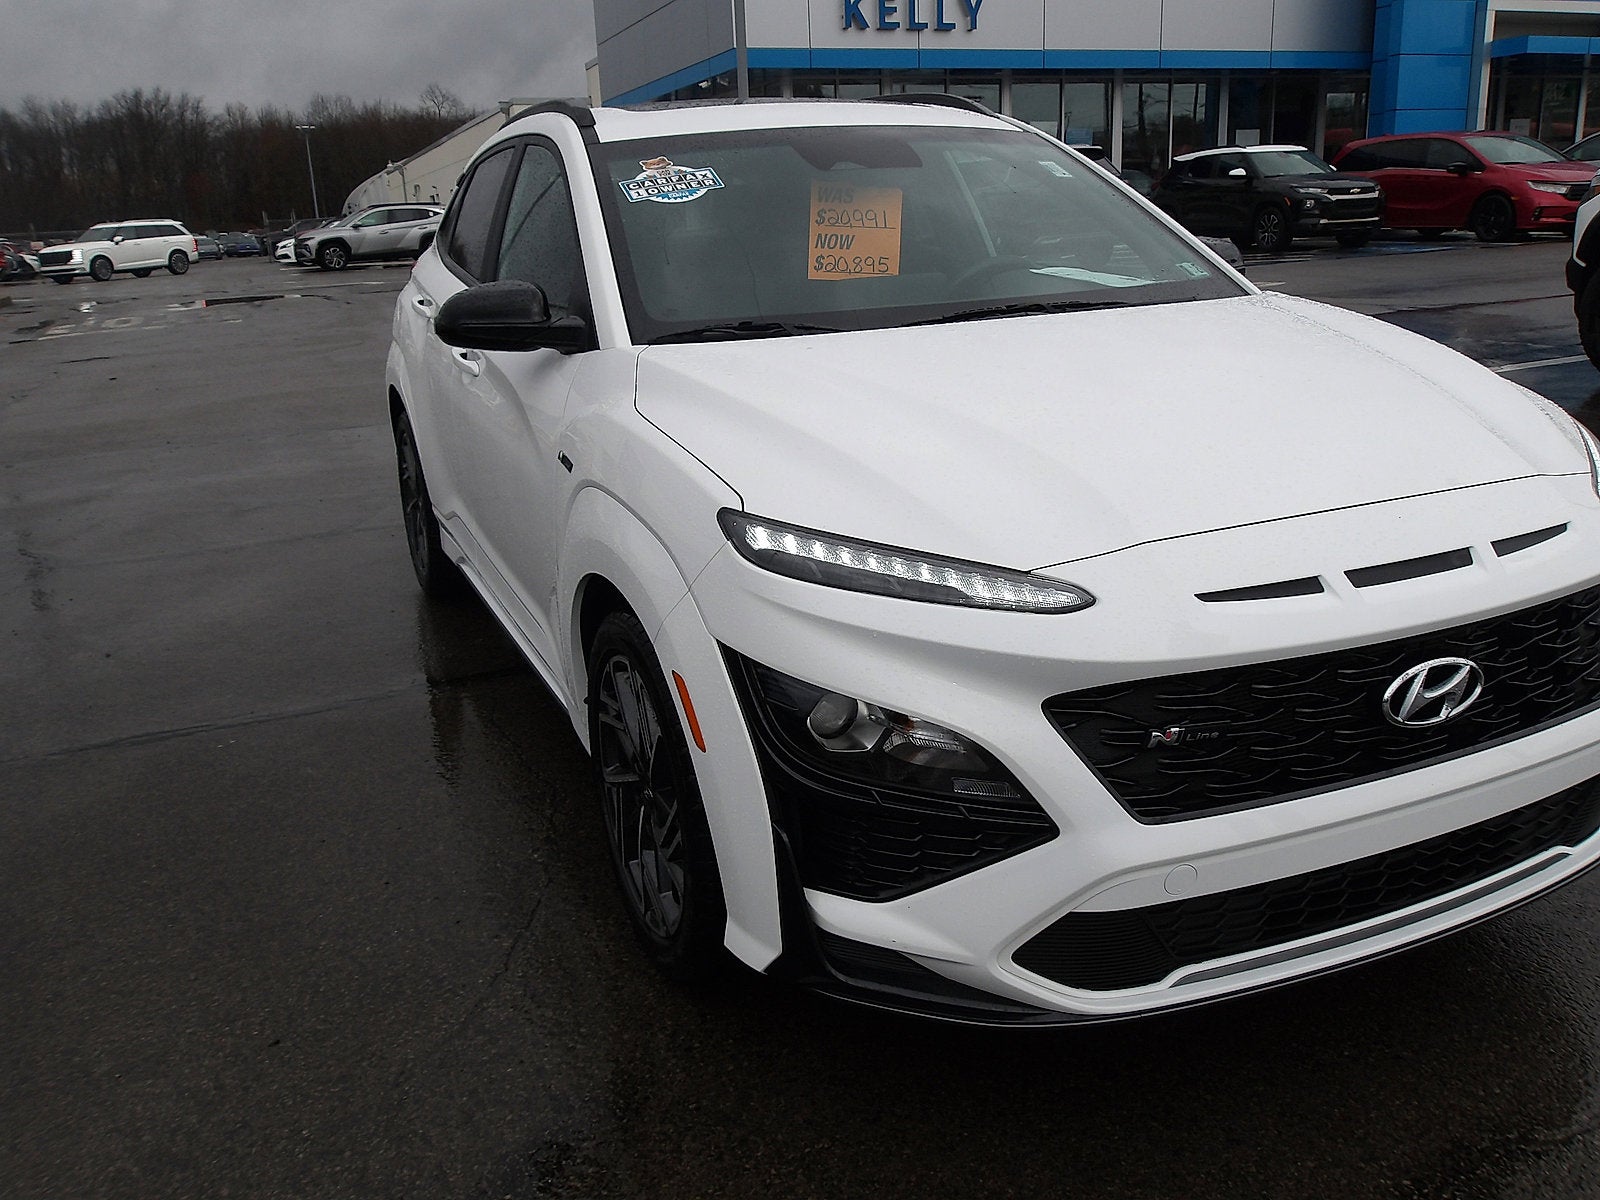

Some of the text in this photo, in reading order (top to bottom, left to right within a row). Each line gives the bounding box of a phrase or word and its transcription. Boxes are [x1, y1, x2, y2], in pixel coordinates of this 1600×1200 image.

[842, 0, 983, 31] KELLY
[628, 172, 709, 189] CARFAX
[647, 179, 715, 195] OWNER
[817, 187, 854, 204] WAS
[815, 208, 887, 228] $20,991
[815, 233, 855, 250] NOW
[814, 254, 889, 275] $20,895
